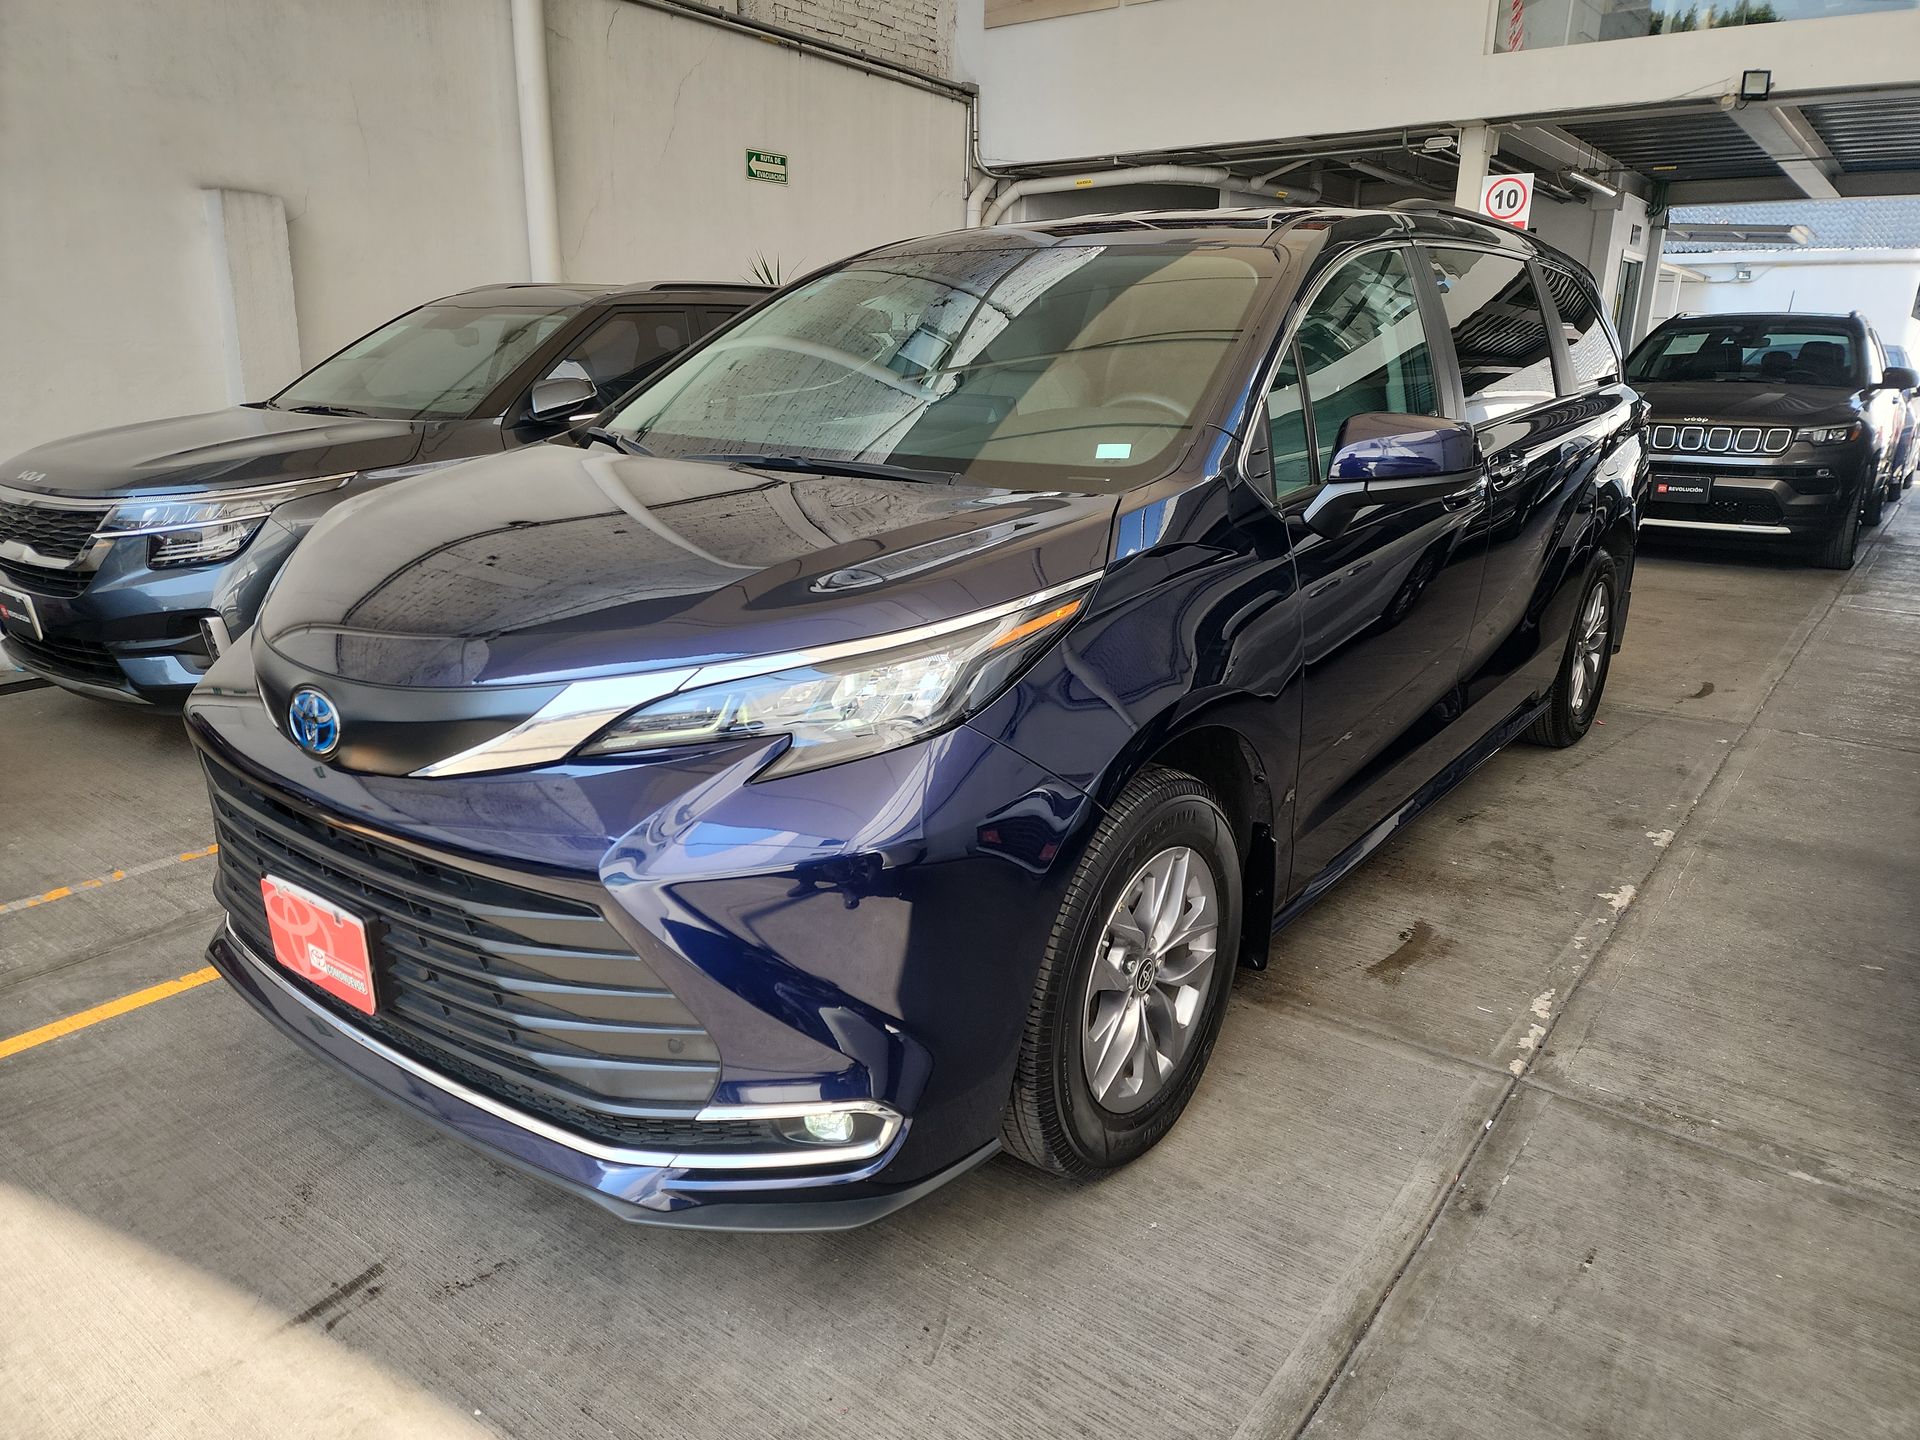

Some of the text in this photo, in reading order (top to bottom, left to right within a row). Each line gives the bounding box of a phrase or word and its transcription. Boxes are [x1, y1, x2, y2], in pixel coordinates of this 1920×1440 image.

[760, 154, 782, 165] RUTA DE
[1494, 188, 1519, 210] 10
[17, 470, 47, 482] KIA
